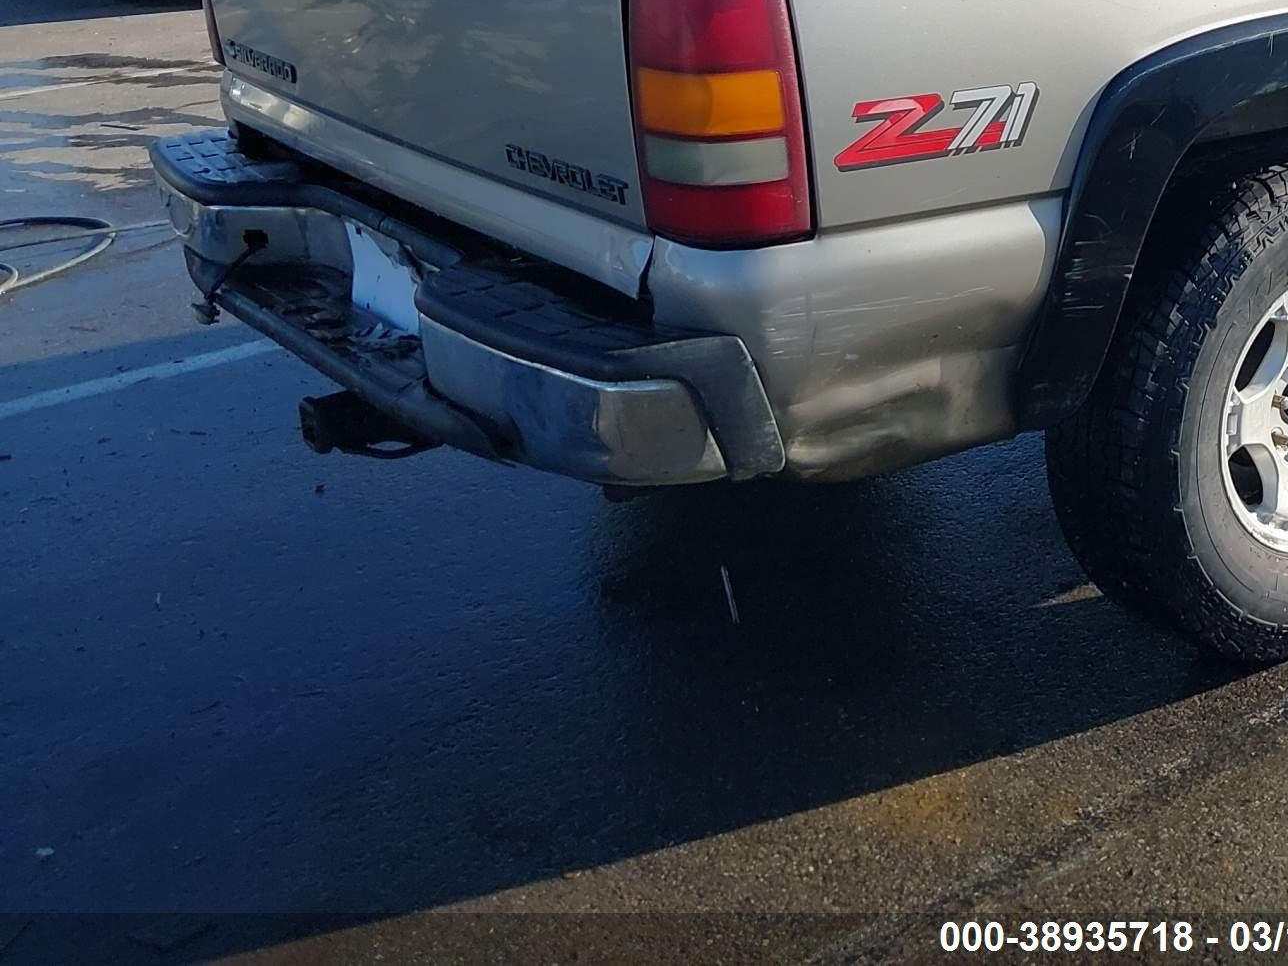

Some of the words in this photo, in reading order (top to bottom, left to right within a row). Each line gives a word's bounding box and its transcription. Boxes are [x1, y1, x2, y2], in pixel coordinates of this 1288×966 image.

[233, 43, 293, 82] SILVERADO
[833, 81, 1041, 173] Z71
[504, 143, 630, 206] CHEVROLET
